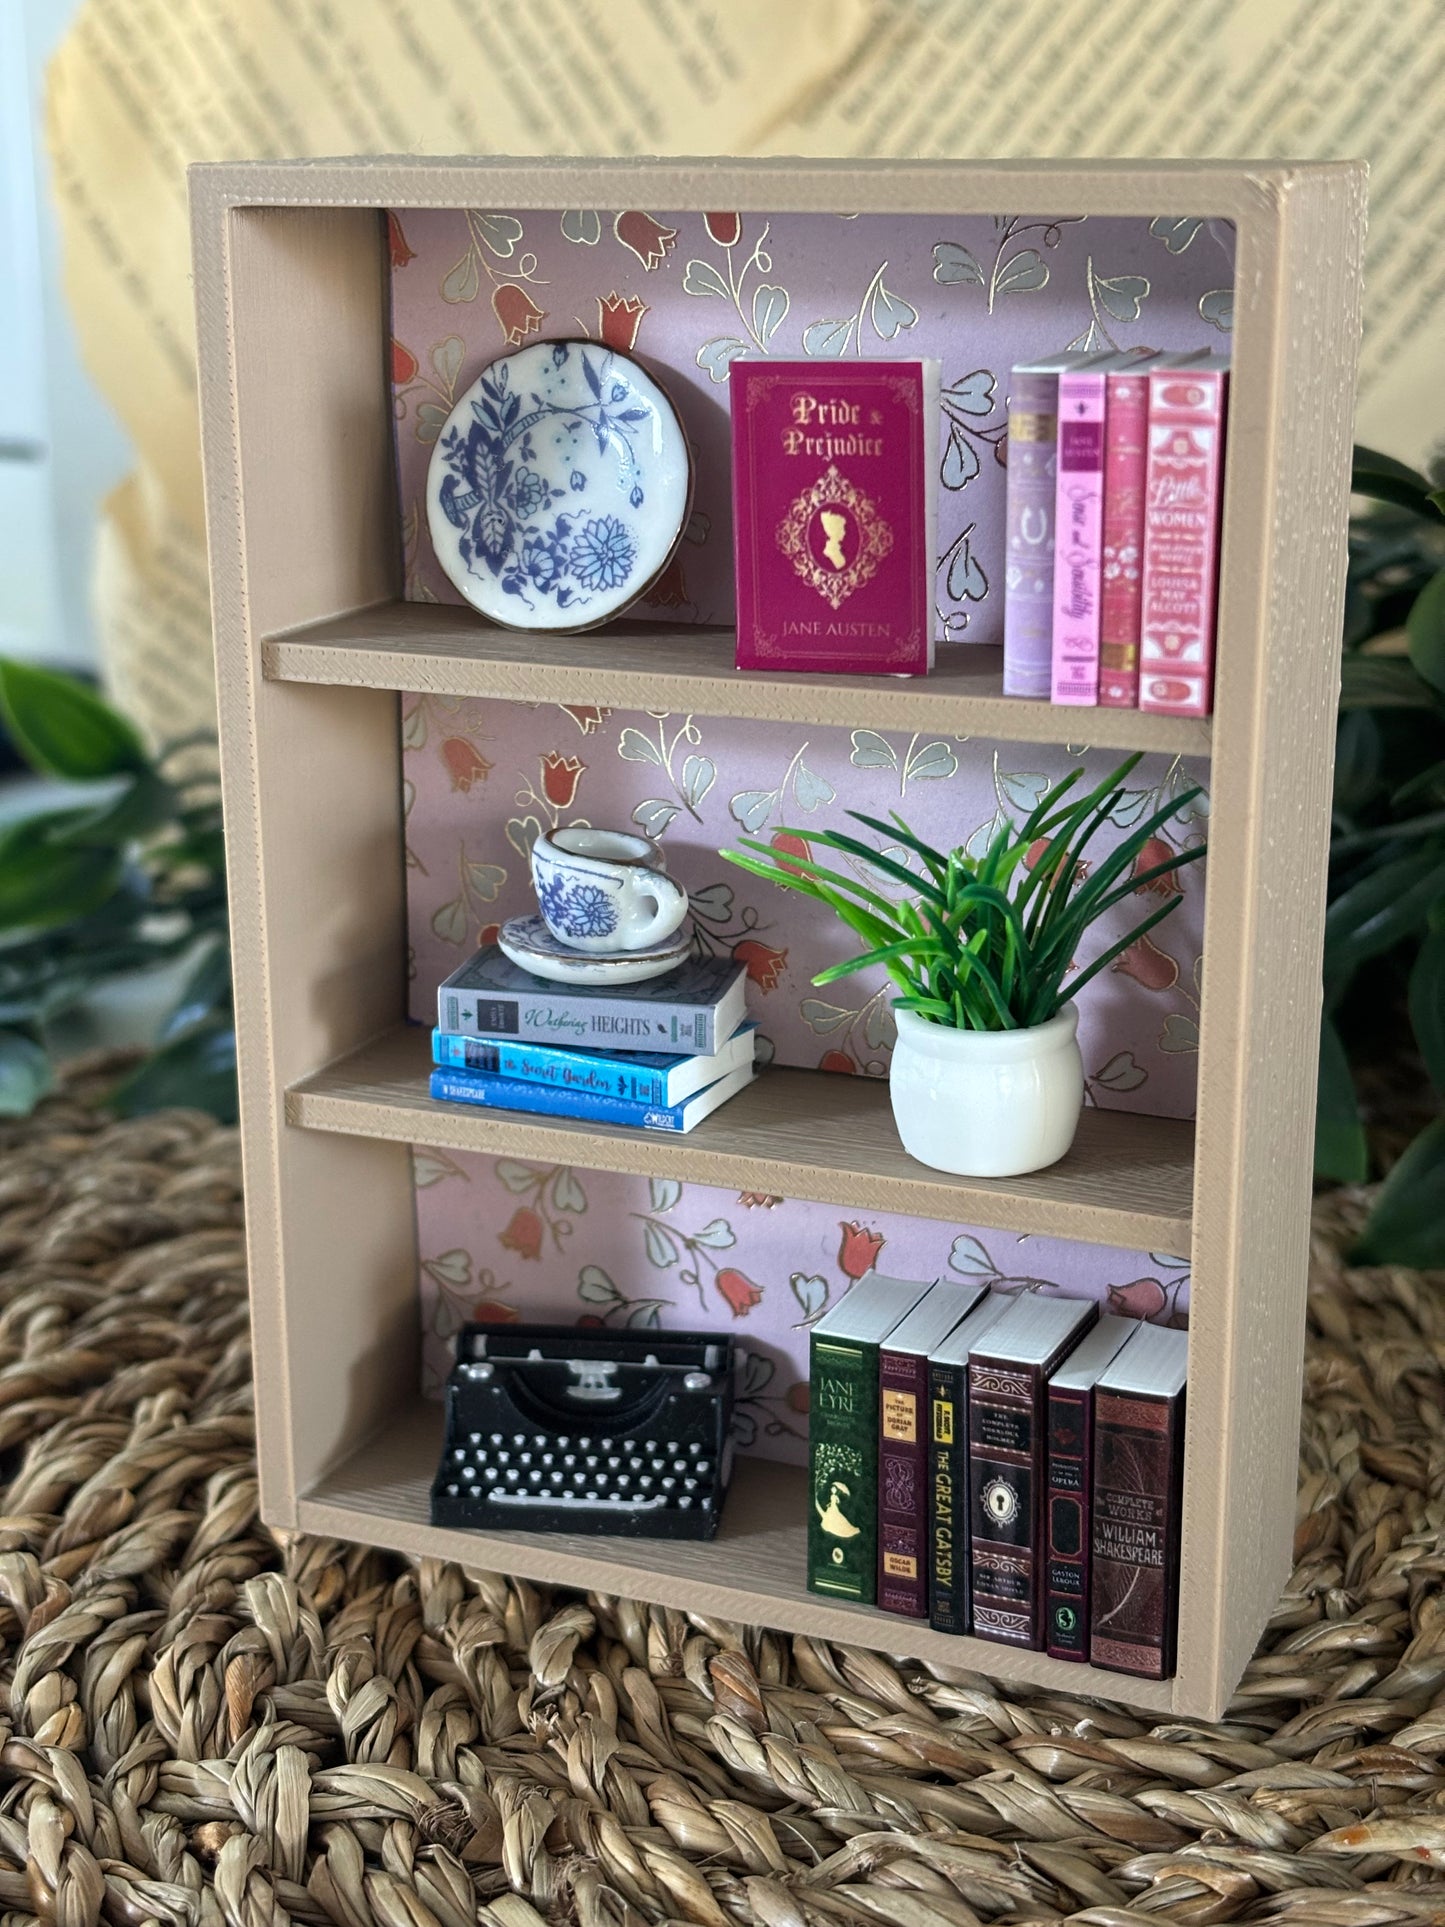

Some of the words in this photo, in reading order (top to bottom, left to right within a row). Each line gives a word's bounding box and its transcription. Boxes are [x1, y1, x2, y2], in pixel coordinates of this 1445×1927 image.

[790, 391, 861, 426] Pride
[780, 427, 884, 461] Prejudice
[1149, 511, 1206, 526] WOMEN
[782, 620, 822, 637] JANE
[825, 623, 891, 638] AUSTEN
[591, 1015, 651, 1036] HEIGHTS
[886, 1404, 914, 1415] PICTURE
[887, 1416, 912, 1427] DORIAN
[891, 1423, 909, 1433] GRAY
[937, 1450, 950, 1472] THE
[1051, 1476, 1080, 1487] OPERA
[935, 1473, 953, 1526] GREAT
[1108, 1503, 1153, 1522] WORKS
[1102, 1522, 1157, 1548] WILLIAM
[889, 1556, 912, 1566] OSCAR
[935, 1527, 953, 1588] GATSBY
[1094, 1537, 1165, 1566] SHAKESPEARE
[1051, 1568, 1081, 1580] GASTON
